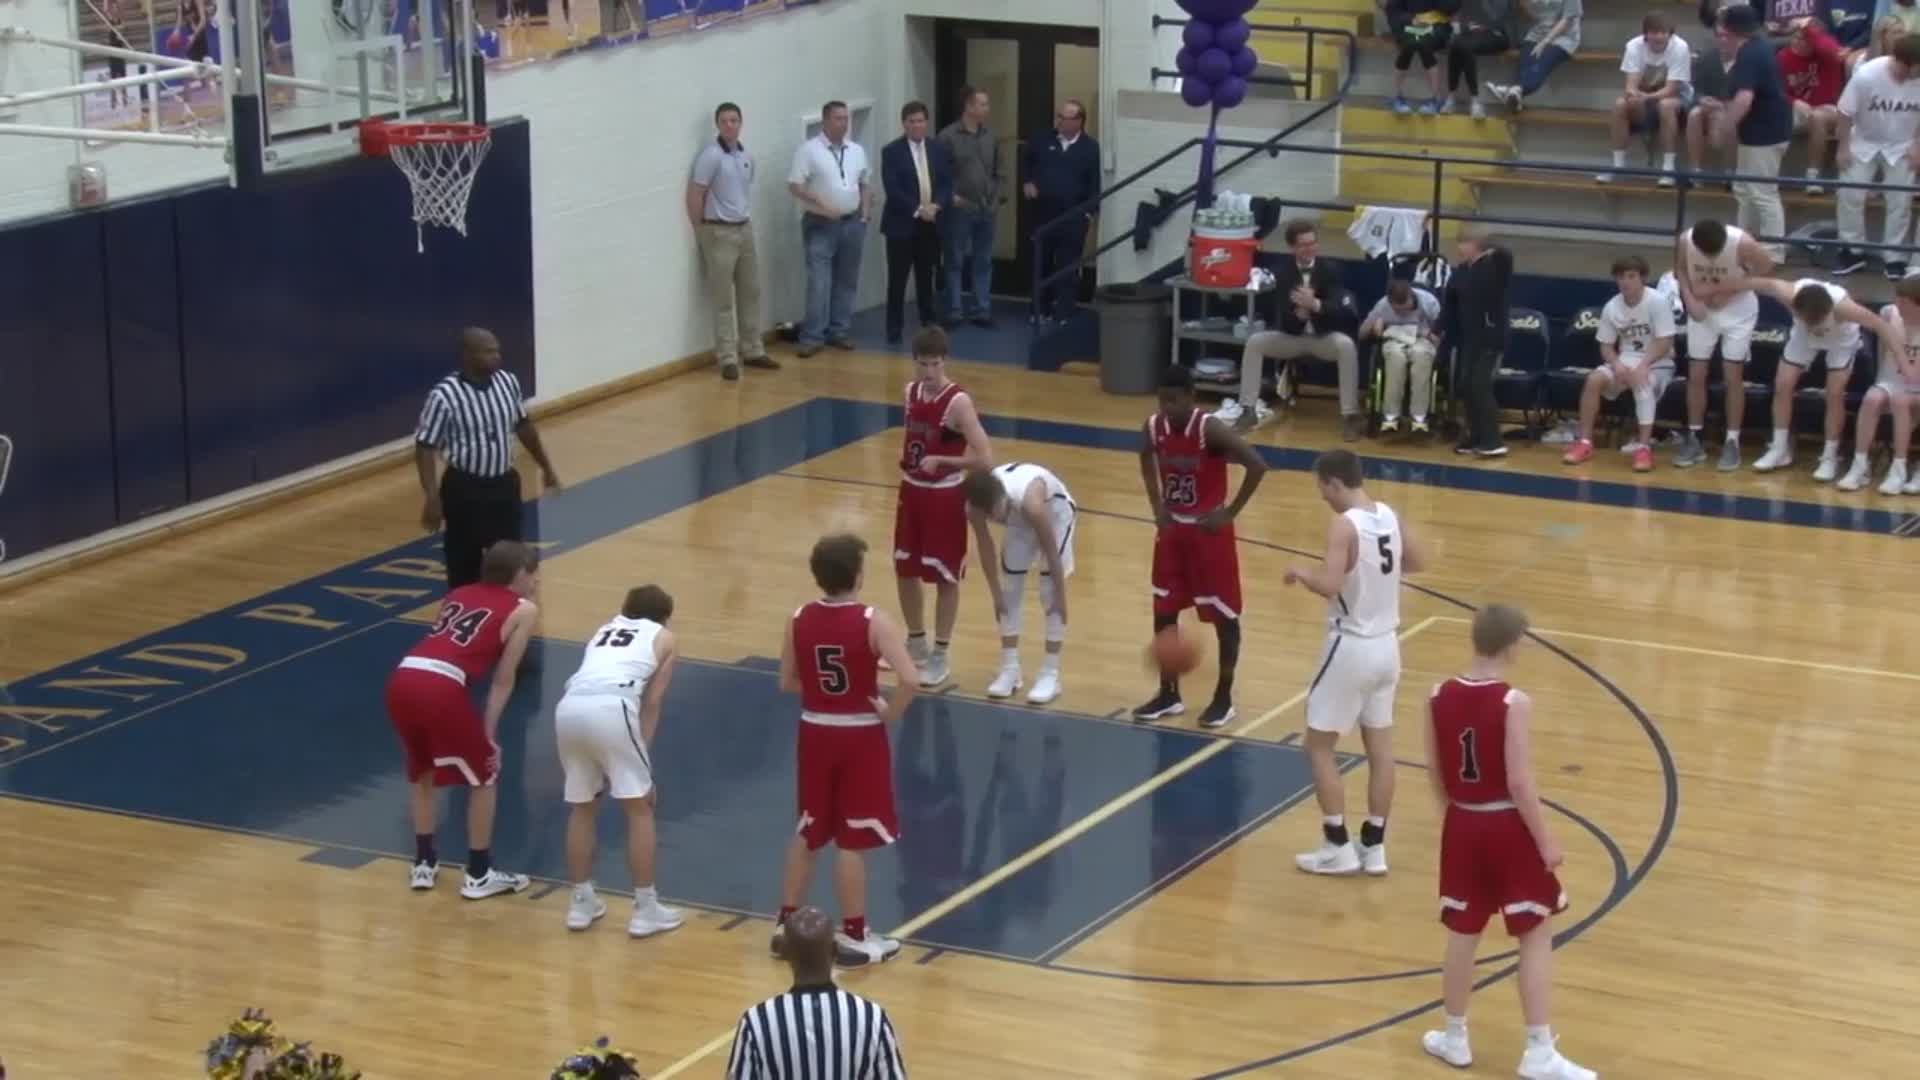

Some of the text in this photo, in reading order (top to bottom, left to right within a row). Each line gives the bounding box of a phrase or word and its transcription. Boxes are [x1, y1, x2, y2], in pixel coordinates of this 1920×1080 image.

[1377, 535, 1394, 575] 5
[430, 601, 492, 647] 34
[594, 628, 639, 648] 15
[815, 644, 849, 696] 5
[1459, 727, 1481, 783] 1
